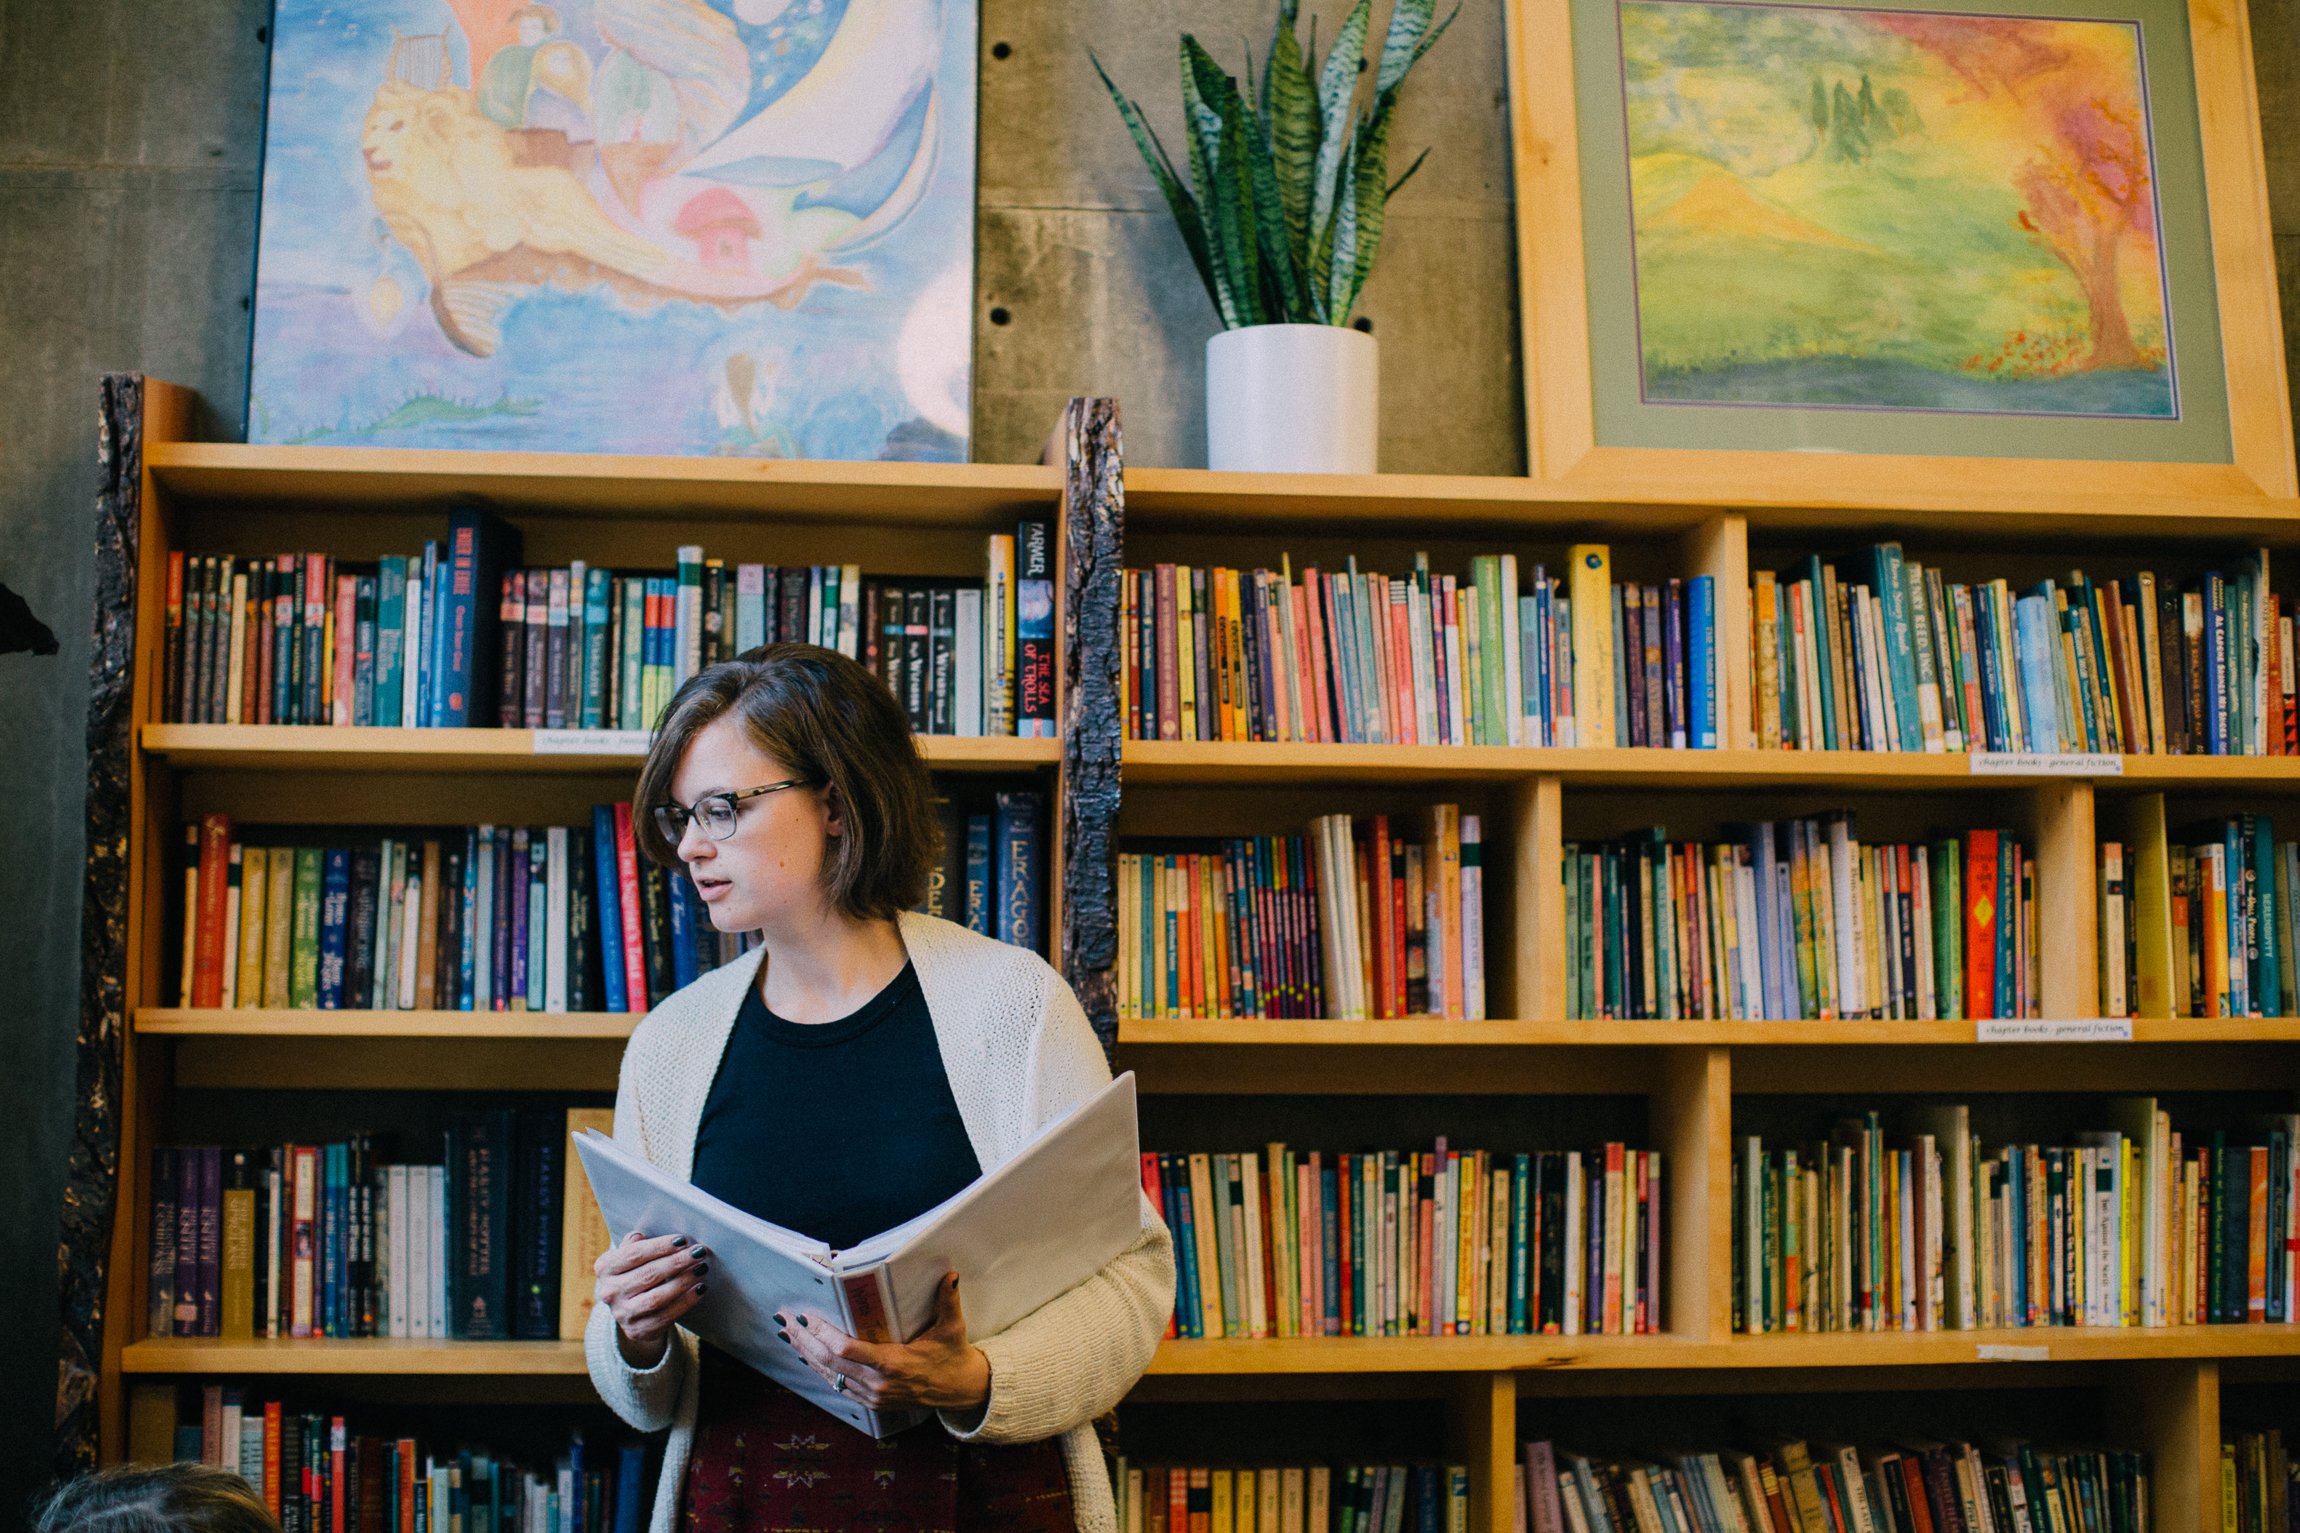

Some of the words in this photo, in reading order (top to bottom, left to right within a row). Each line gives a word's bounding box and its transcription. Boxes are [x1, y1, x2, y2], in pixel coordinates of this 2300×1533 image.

[1027, 523, 1045, 576] FARMER
[1909, 568, 1925, 610] HENRY
[2215, 615, 2224, 627] AL
[1024, 644, 1036, 657] OF
[2215, 629, 2225, 662] CAPONE
[1038, 654, 1051, 677] THE
[1022, 666, 1037, 713] TROLLS
[2217, 664, 2226, 694] SHINES
[1039, 683, 1051, 704] SEA
[2218, 696, 2226, 709] MY
[2219, 712, 2227, 739] SHOES
[2048, 759, 2084, 769] general
[2262, 894, 2273, 958] SERENDIPITY
[1986, 1025, 2021, 1035] chapter
[2056, 1024, 2091, 1035] general
